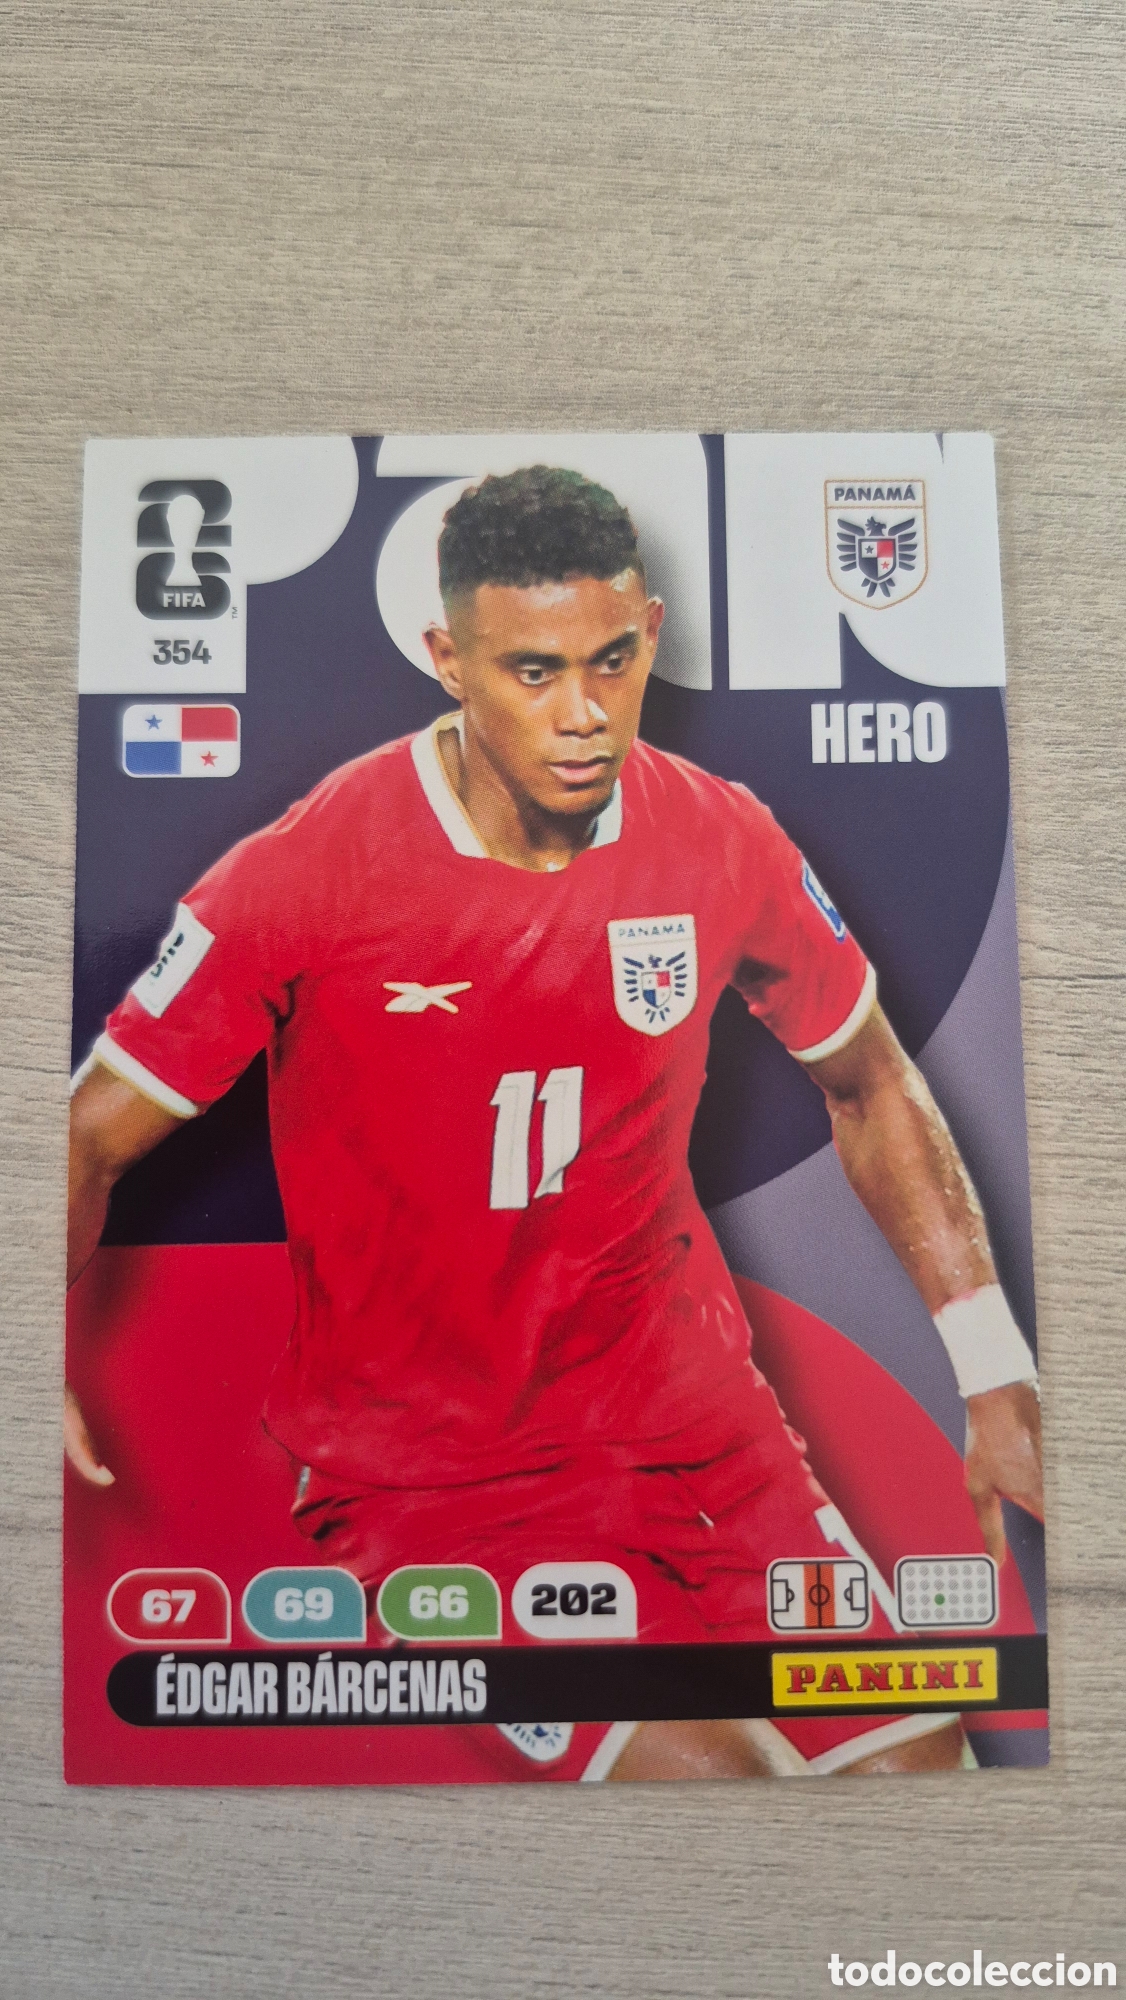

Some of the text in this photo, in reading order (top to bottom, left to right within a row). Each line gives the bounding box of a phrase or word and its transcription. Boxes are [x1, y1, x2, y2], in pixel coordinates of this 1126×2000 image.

[834, 484, 916, 502] PANAMÁ
[162, 592, 206, 608] FIFA
[152, 639, 212, 665] 354
[811, 702, 947, 764] HERO
[489, 1066, 584, 1210] 11
[142, 1589, 198, 1623] 67
[274, 1586, 334, 1621] 69
[409, 1584, 470, 1619] 66
[532, 1582, 618, 1616] 202
[156, 1651, 488, 1715] ÉDGAR BÁRCENAS
[786, 1659, 984, 1694] PANINI
